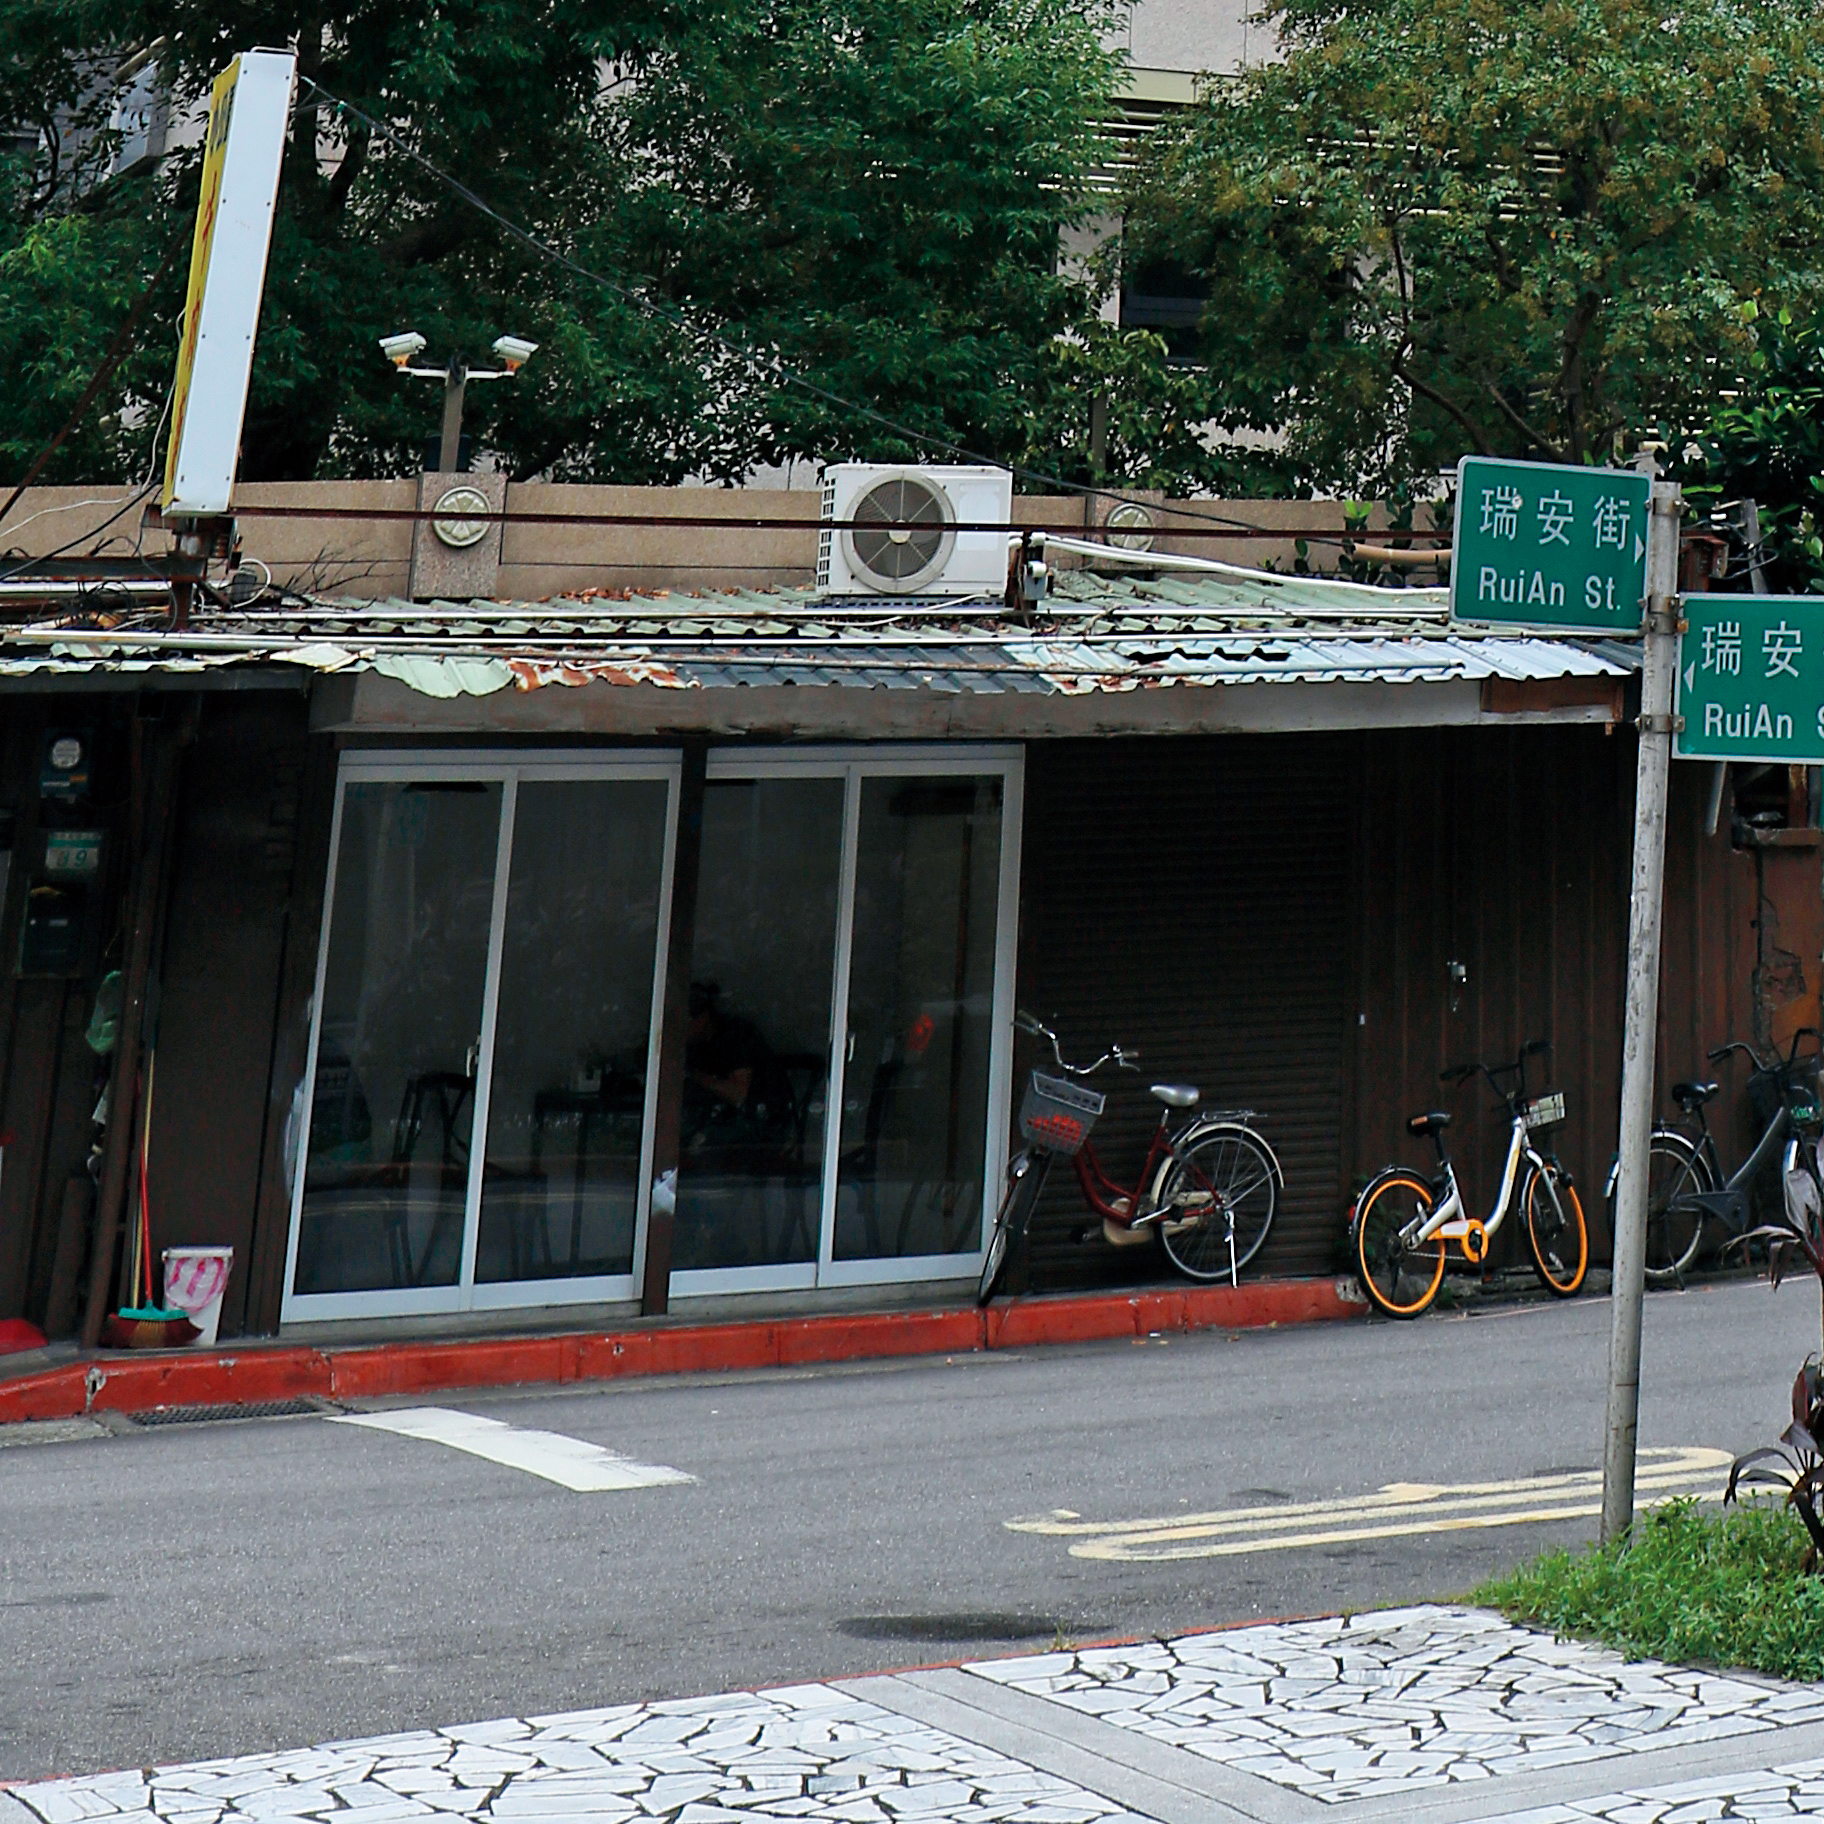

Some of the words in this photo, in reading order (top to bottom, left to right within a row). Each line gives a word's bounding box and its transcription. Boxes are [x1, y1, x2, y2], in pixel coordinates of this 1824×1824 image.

[1479, 485, 1631, 551] 瑞安街
[1478, 566, 1566, 607] RuiAn
[1584, 574, 1622, 611] St.
[1703, 703, 1793, 740] RuiAn
